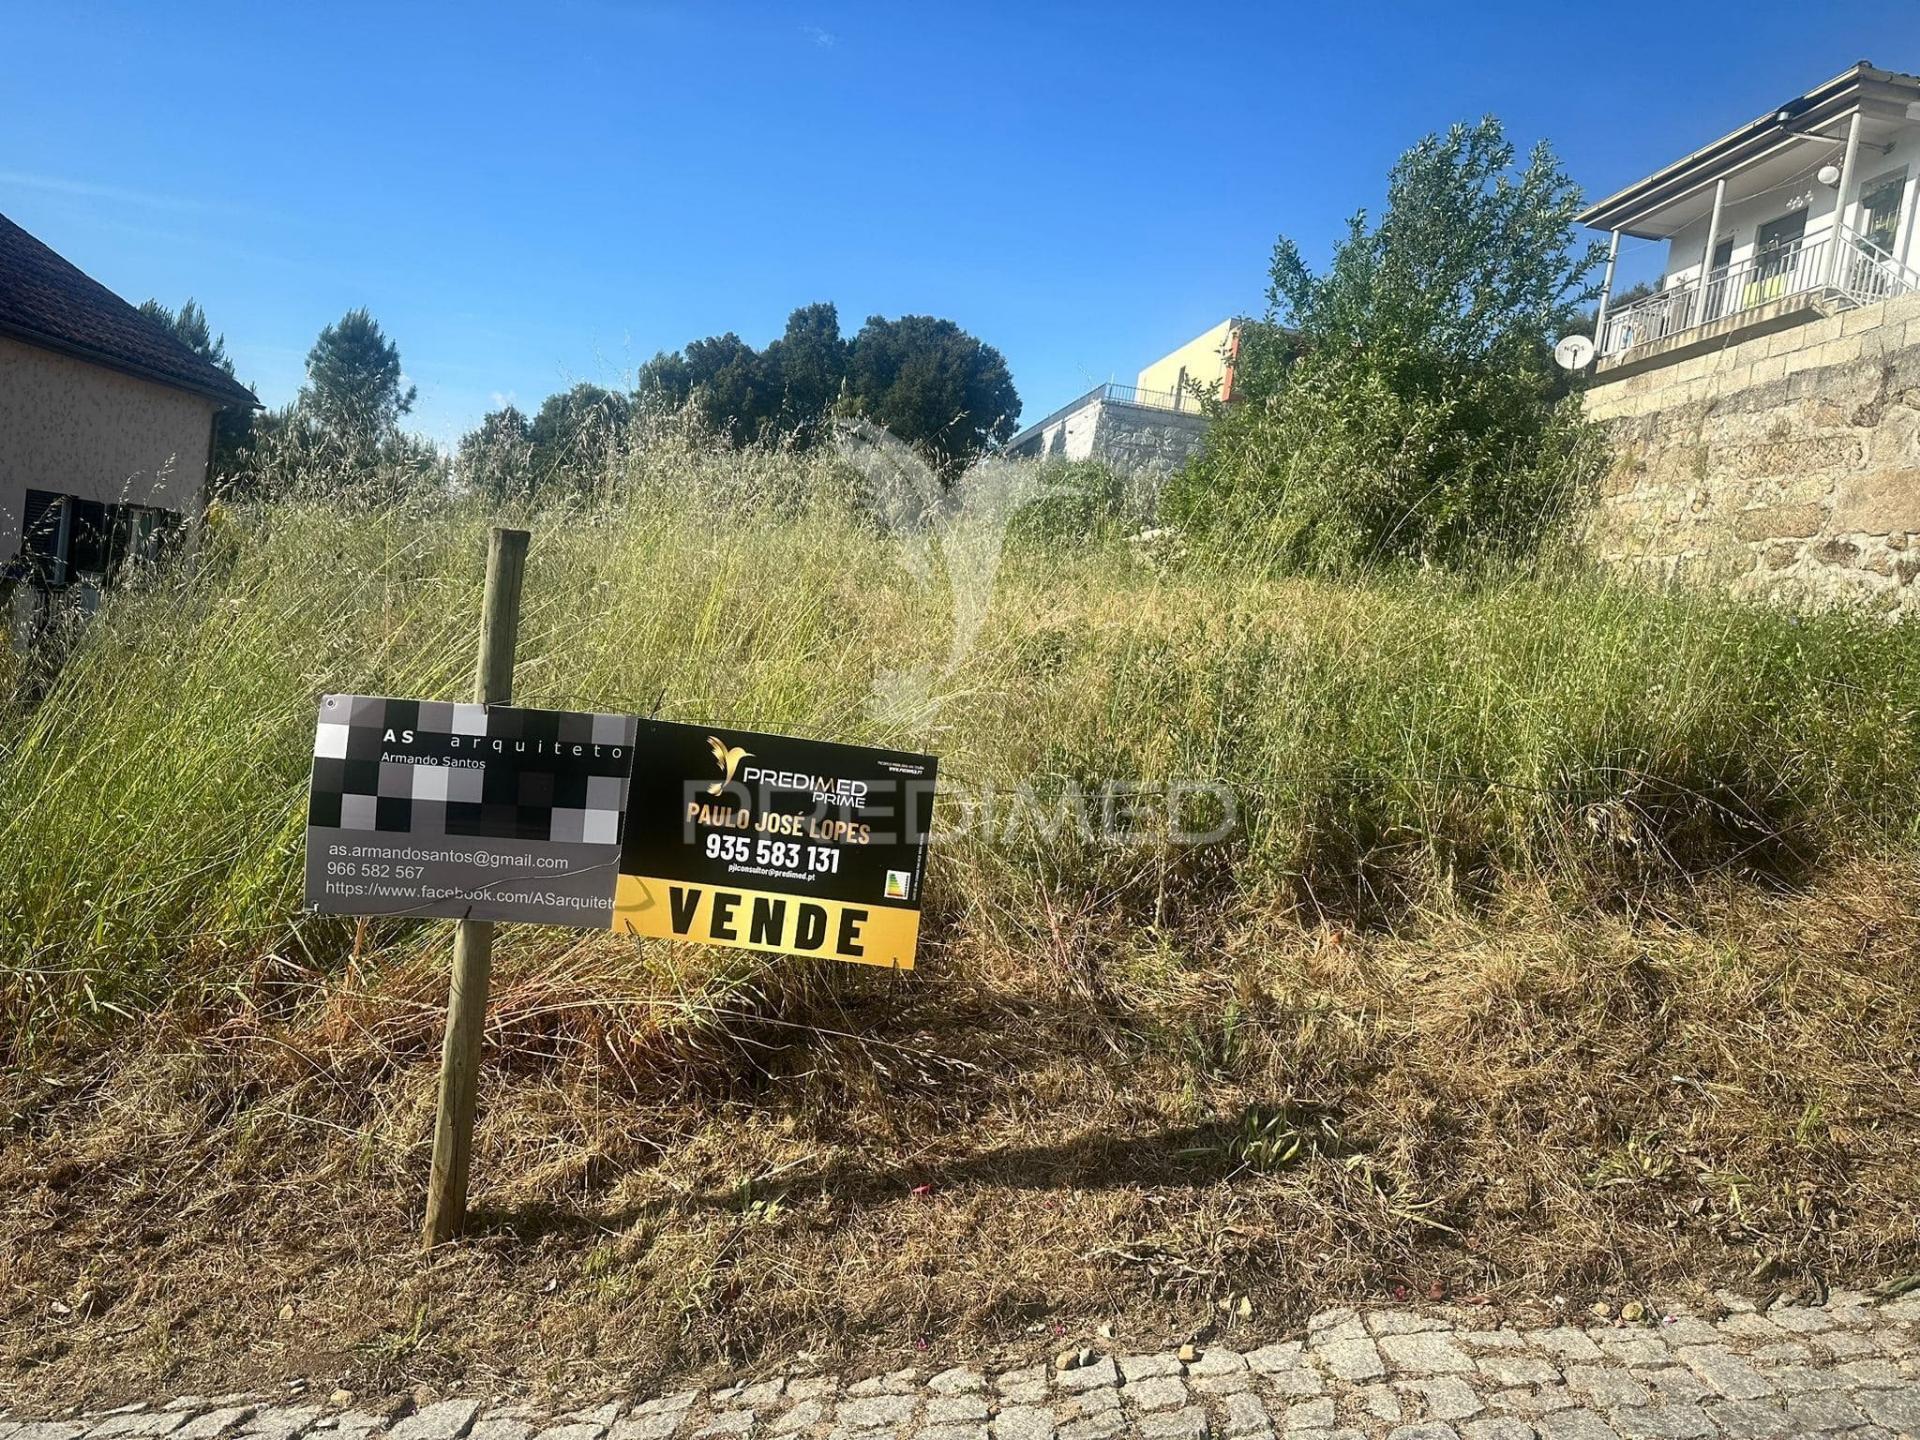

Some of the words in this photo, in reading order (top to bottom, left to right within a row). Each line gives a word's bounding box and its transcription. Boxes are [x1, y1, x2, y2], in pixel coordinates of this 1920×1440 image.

[383, 729, 414, 744] AS
[450, 735, 622, 759] arquiteto
[381, 751, 438, 766] Armando
[442, 756, 486, 769] Santos
[743, 767, 868, 796] PREDIMED
[812, 793, 866, 808] PRIME
[687, 802, 749, 829] PAULO
[755, 811, 805, 836] JOSÉ
[809, 818, 871, 844] LOPES
[329, 843, 569, 869] as.armandosantos@gmail.com
[705, 833, 750, 862] 935
[756, 840, 799, 869] 583
[806, 846, 840, 873] 131
[327, 861, 356, 877] 966
[361, 864, 391, 878] 582
[395, 866, 425, 879] 567
[668, 886, 868, 957] VENDE
